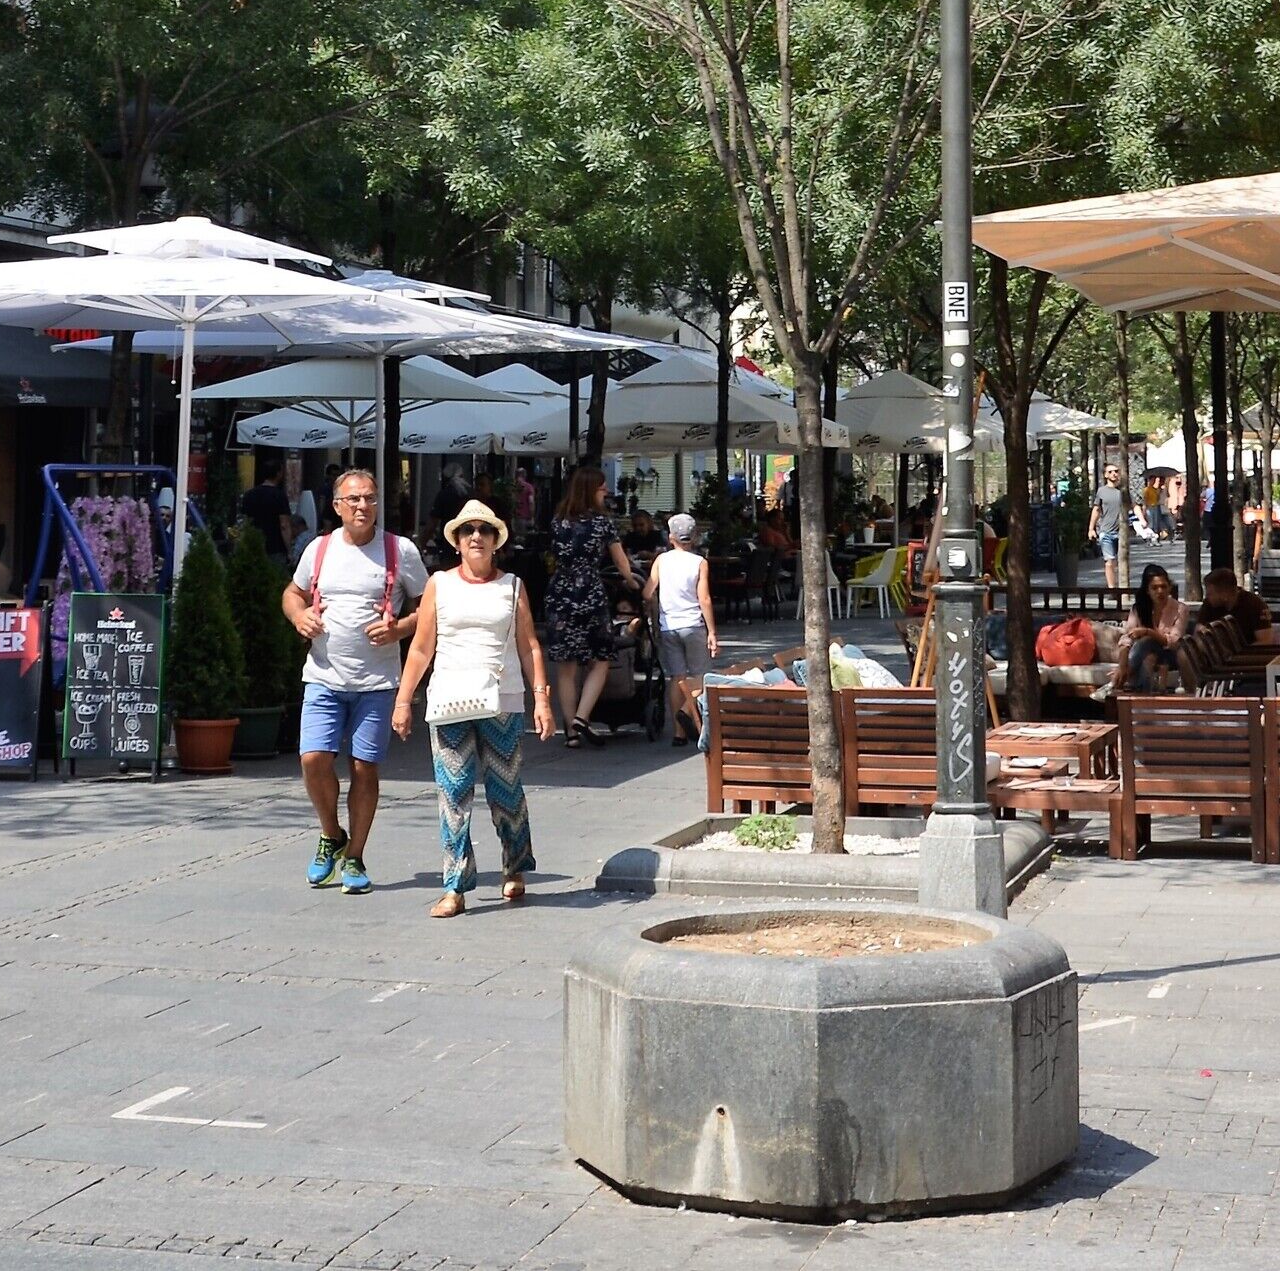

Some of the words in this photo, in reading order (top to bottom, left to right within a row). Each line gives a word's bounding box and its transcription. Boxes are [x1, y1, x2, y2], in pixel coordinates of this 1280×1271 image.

[948, 285, 966, 318] BNE
[118, 643, 154, 653] COFFEE
[93, 670, 109, 682] TEA
[70, 691, 83, 702] ICE
[86, 692, 111, 703] CREAM
[117, 692, 141, 702] FRESH
[118, 703, 158, 714] SQUEEZED
[70, 737, 98, 750] CUPS
[115, 737, 150, 753] JUICES
